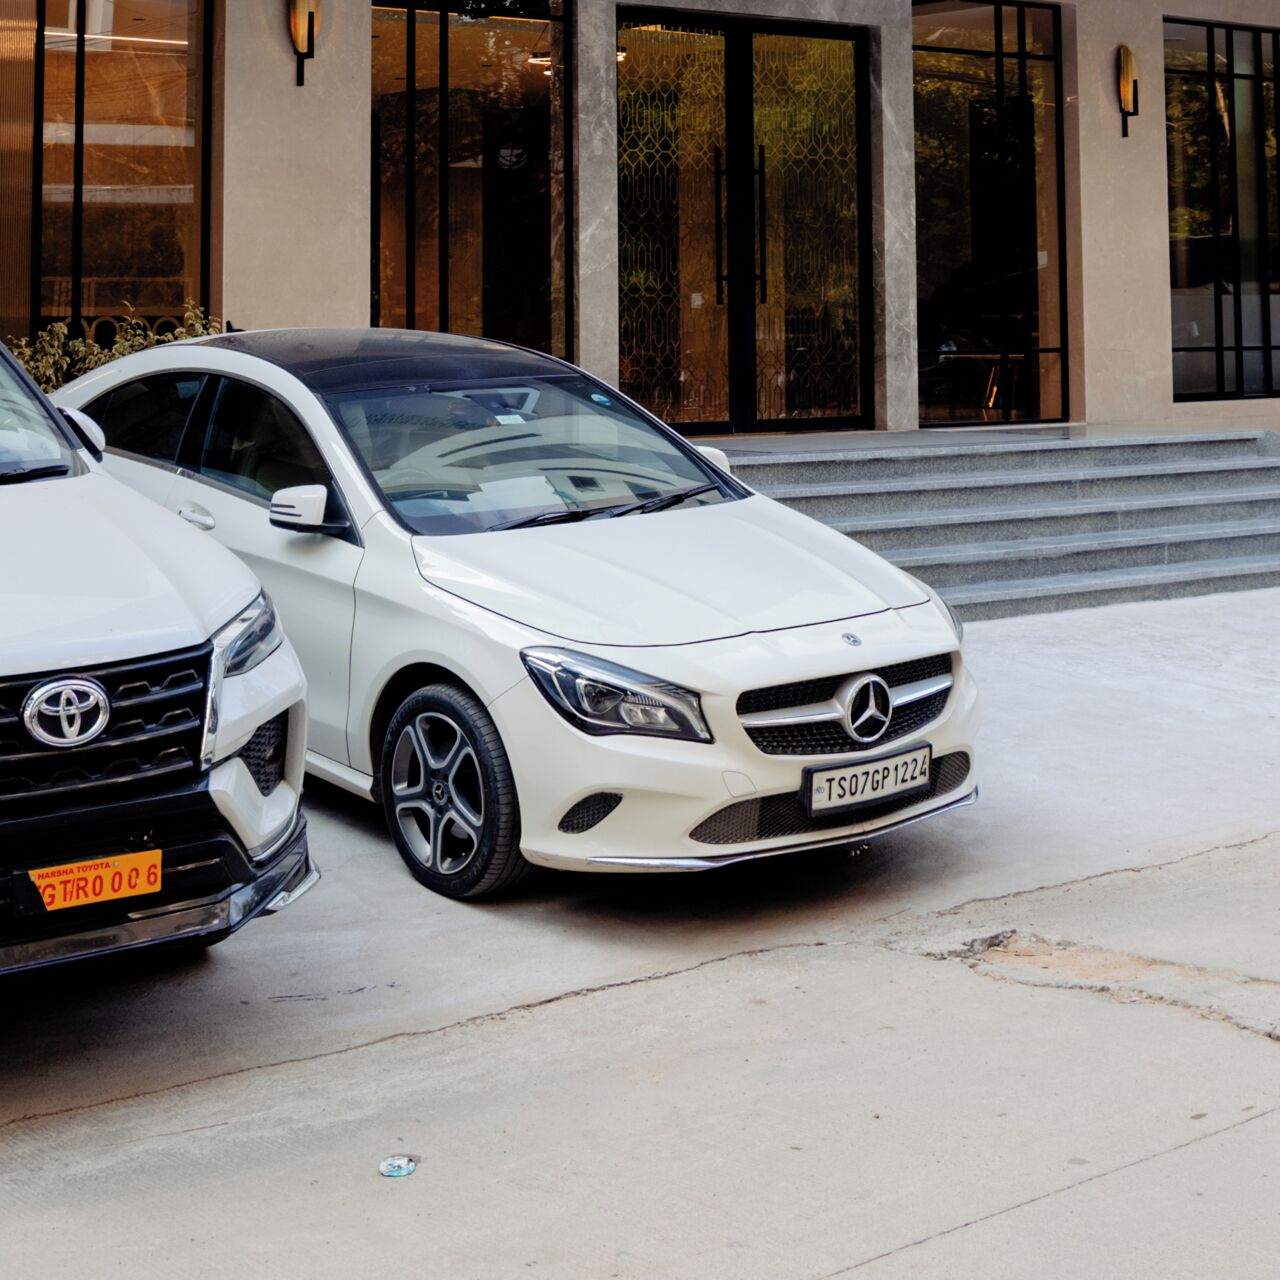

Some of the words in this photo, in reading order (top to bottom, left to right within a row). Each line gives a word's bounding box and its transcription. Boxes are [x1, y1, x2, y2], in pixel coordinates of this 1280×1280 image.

[825, 754, 928, 801] TS07GP1224
[37, 868, 74, 880] HARSHA
[76, 862, 111, 874] TOYOTA
